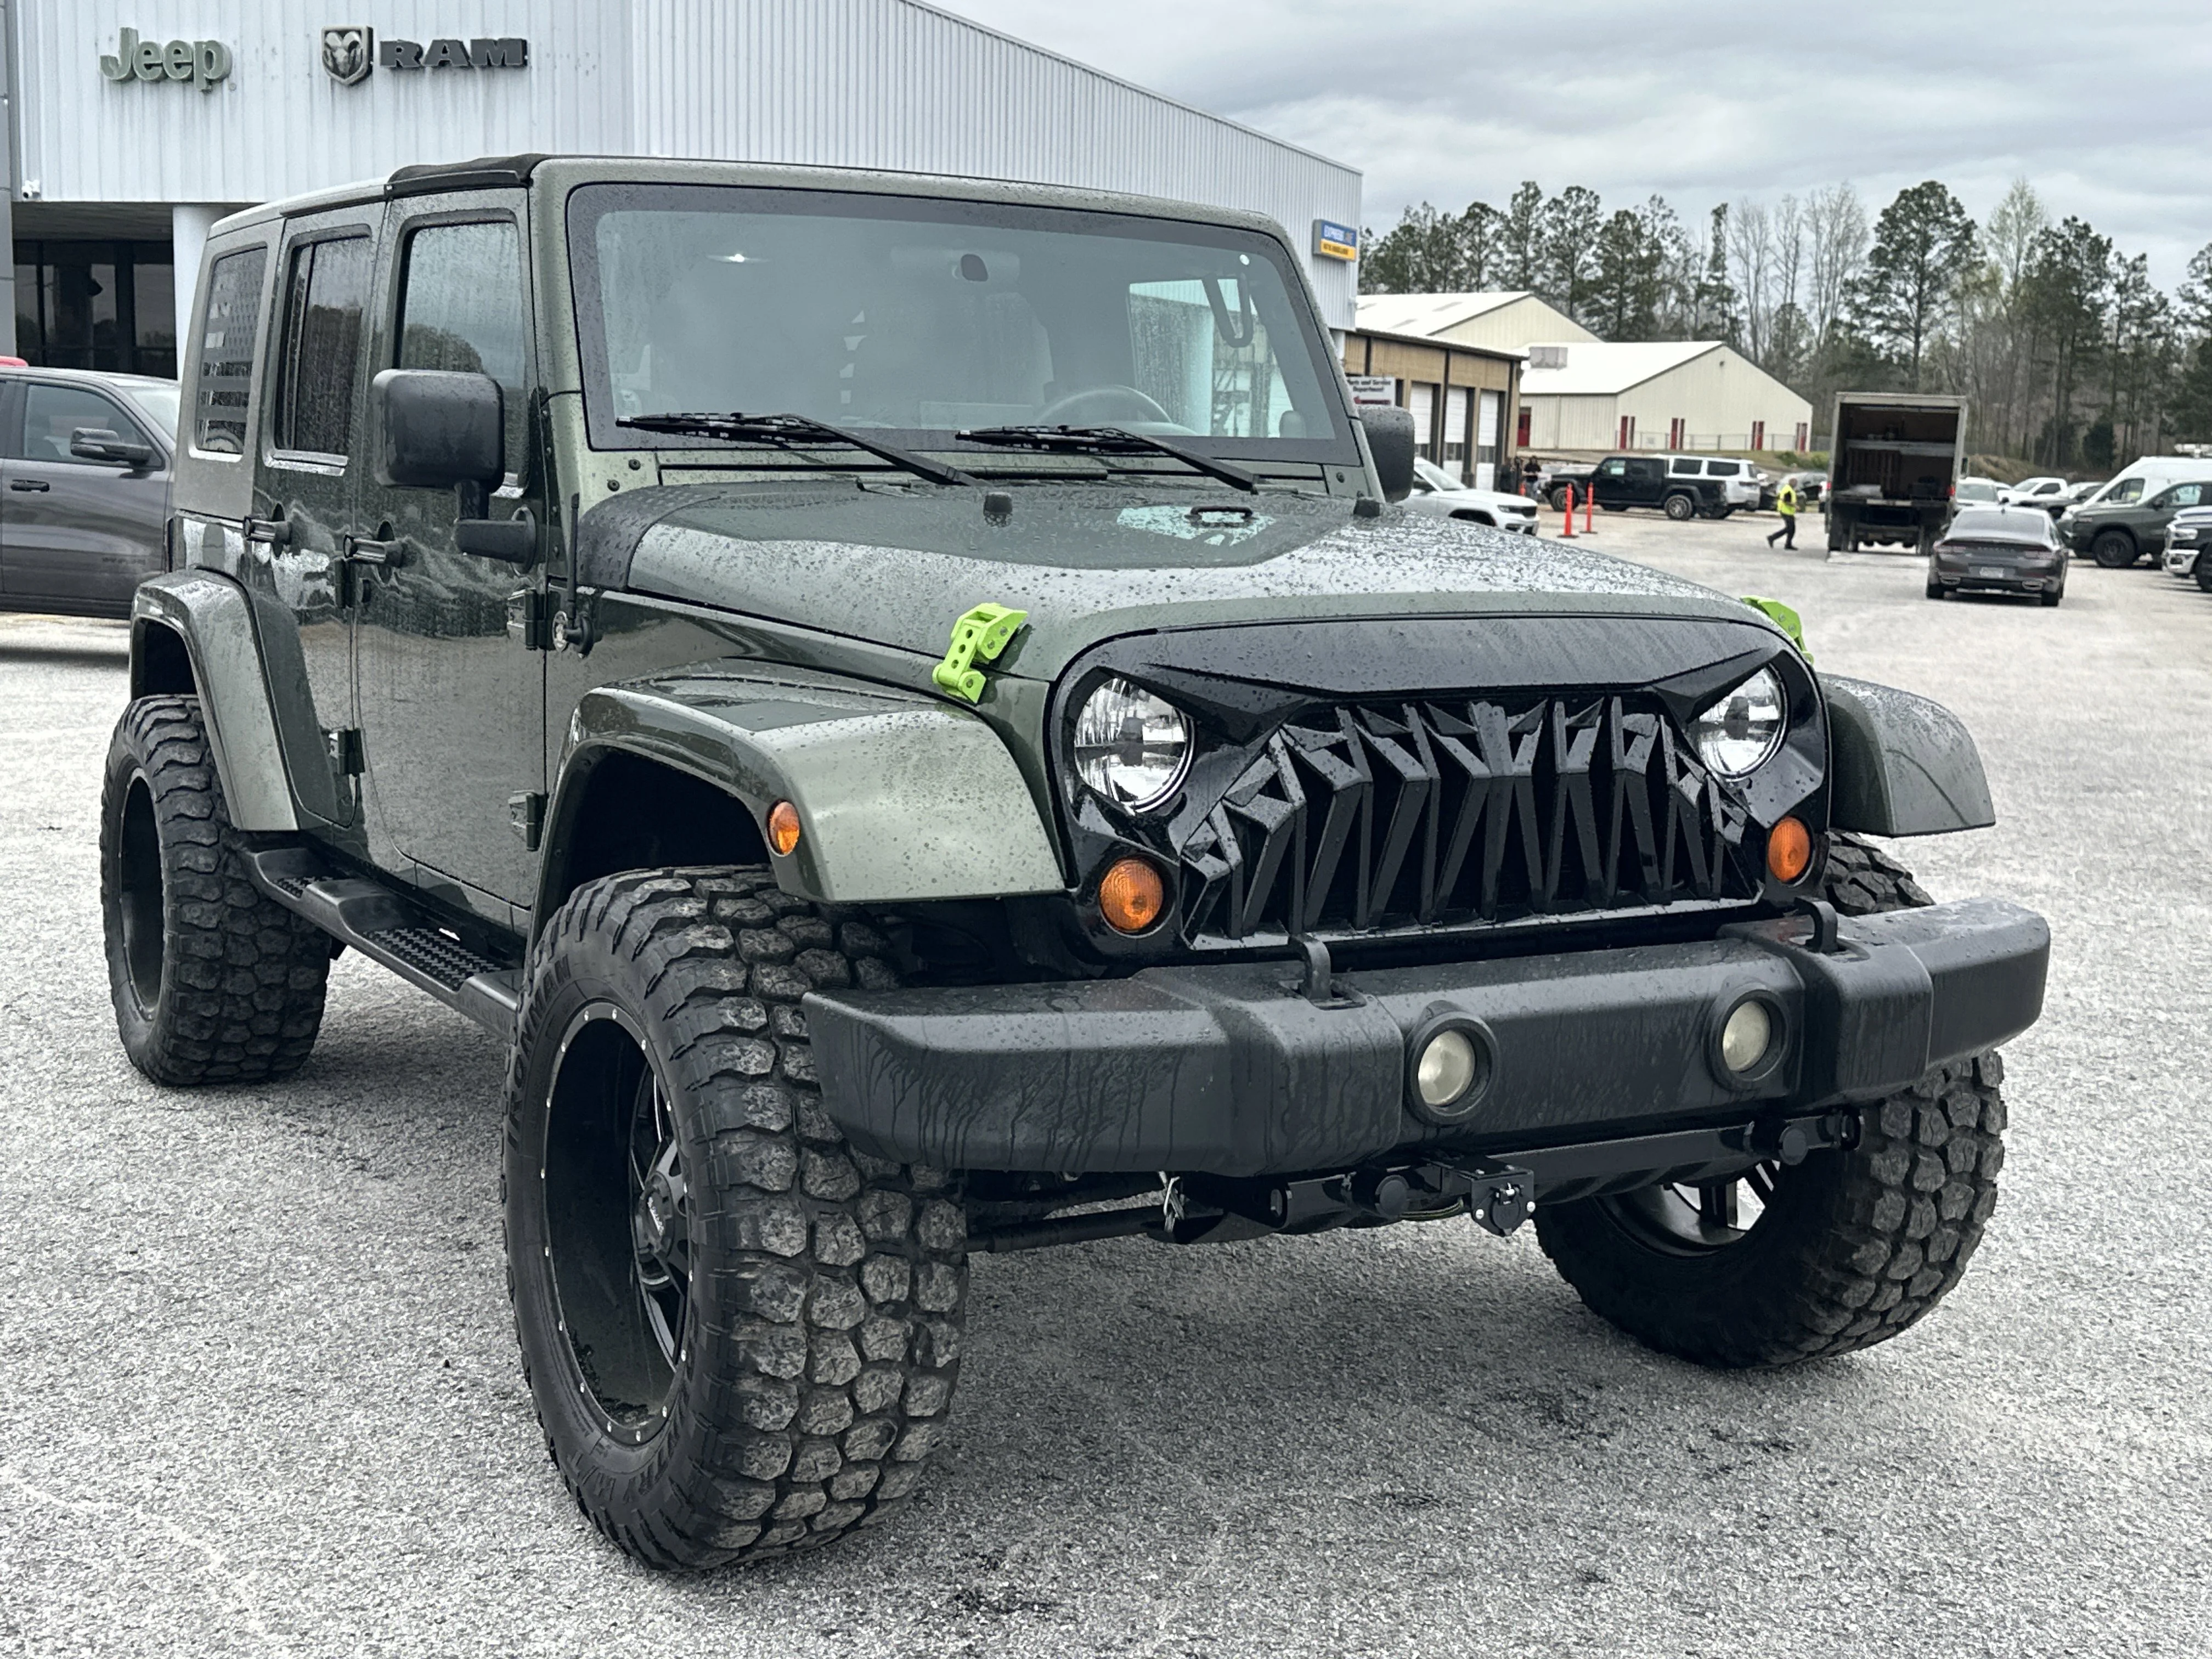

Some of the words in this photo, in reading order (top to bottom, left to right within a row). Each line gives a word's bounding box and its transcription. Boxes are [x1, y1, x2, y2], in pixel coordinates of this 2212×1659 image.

[100, 27, 233, 92] Jeep
[380, 37, 528, 67] RAM
[507, 953, 572, 1154] IRONMAN
